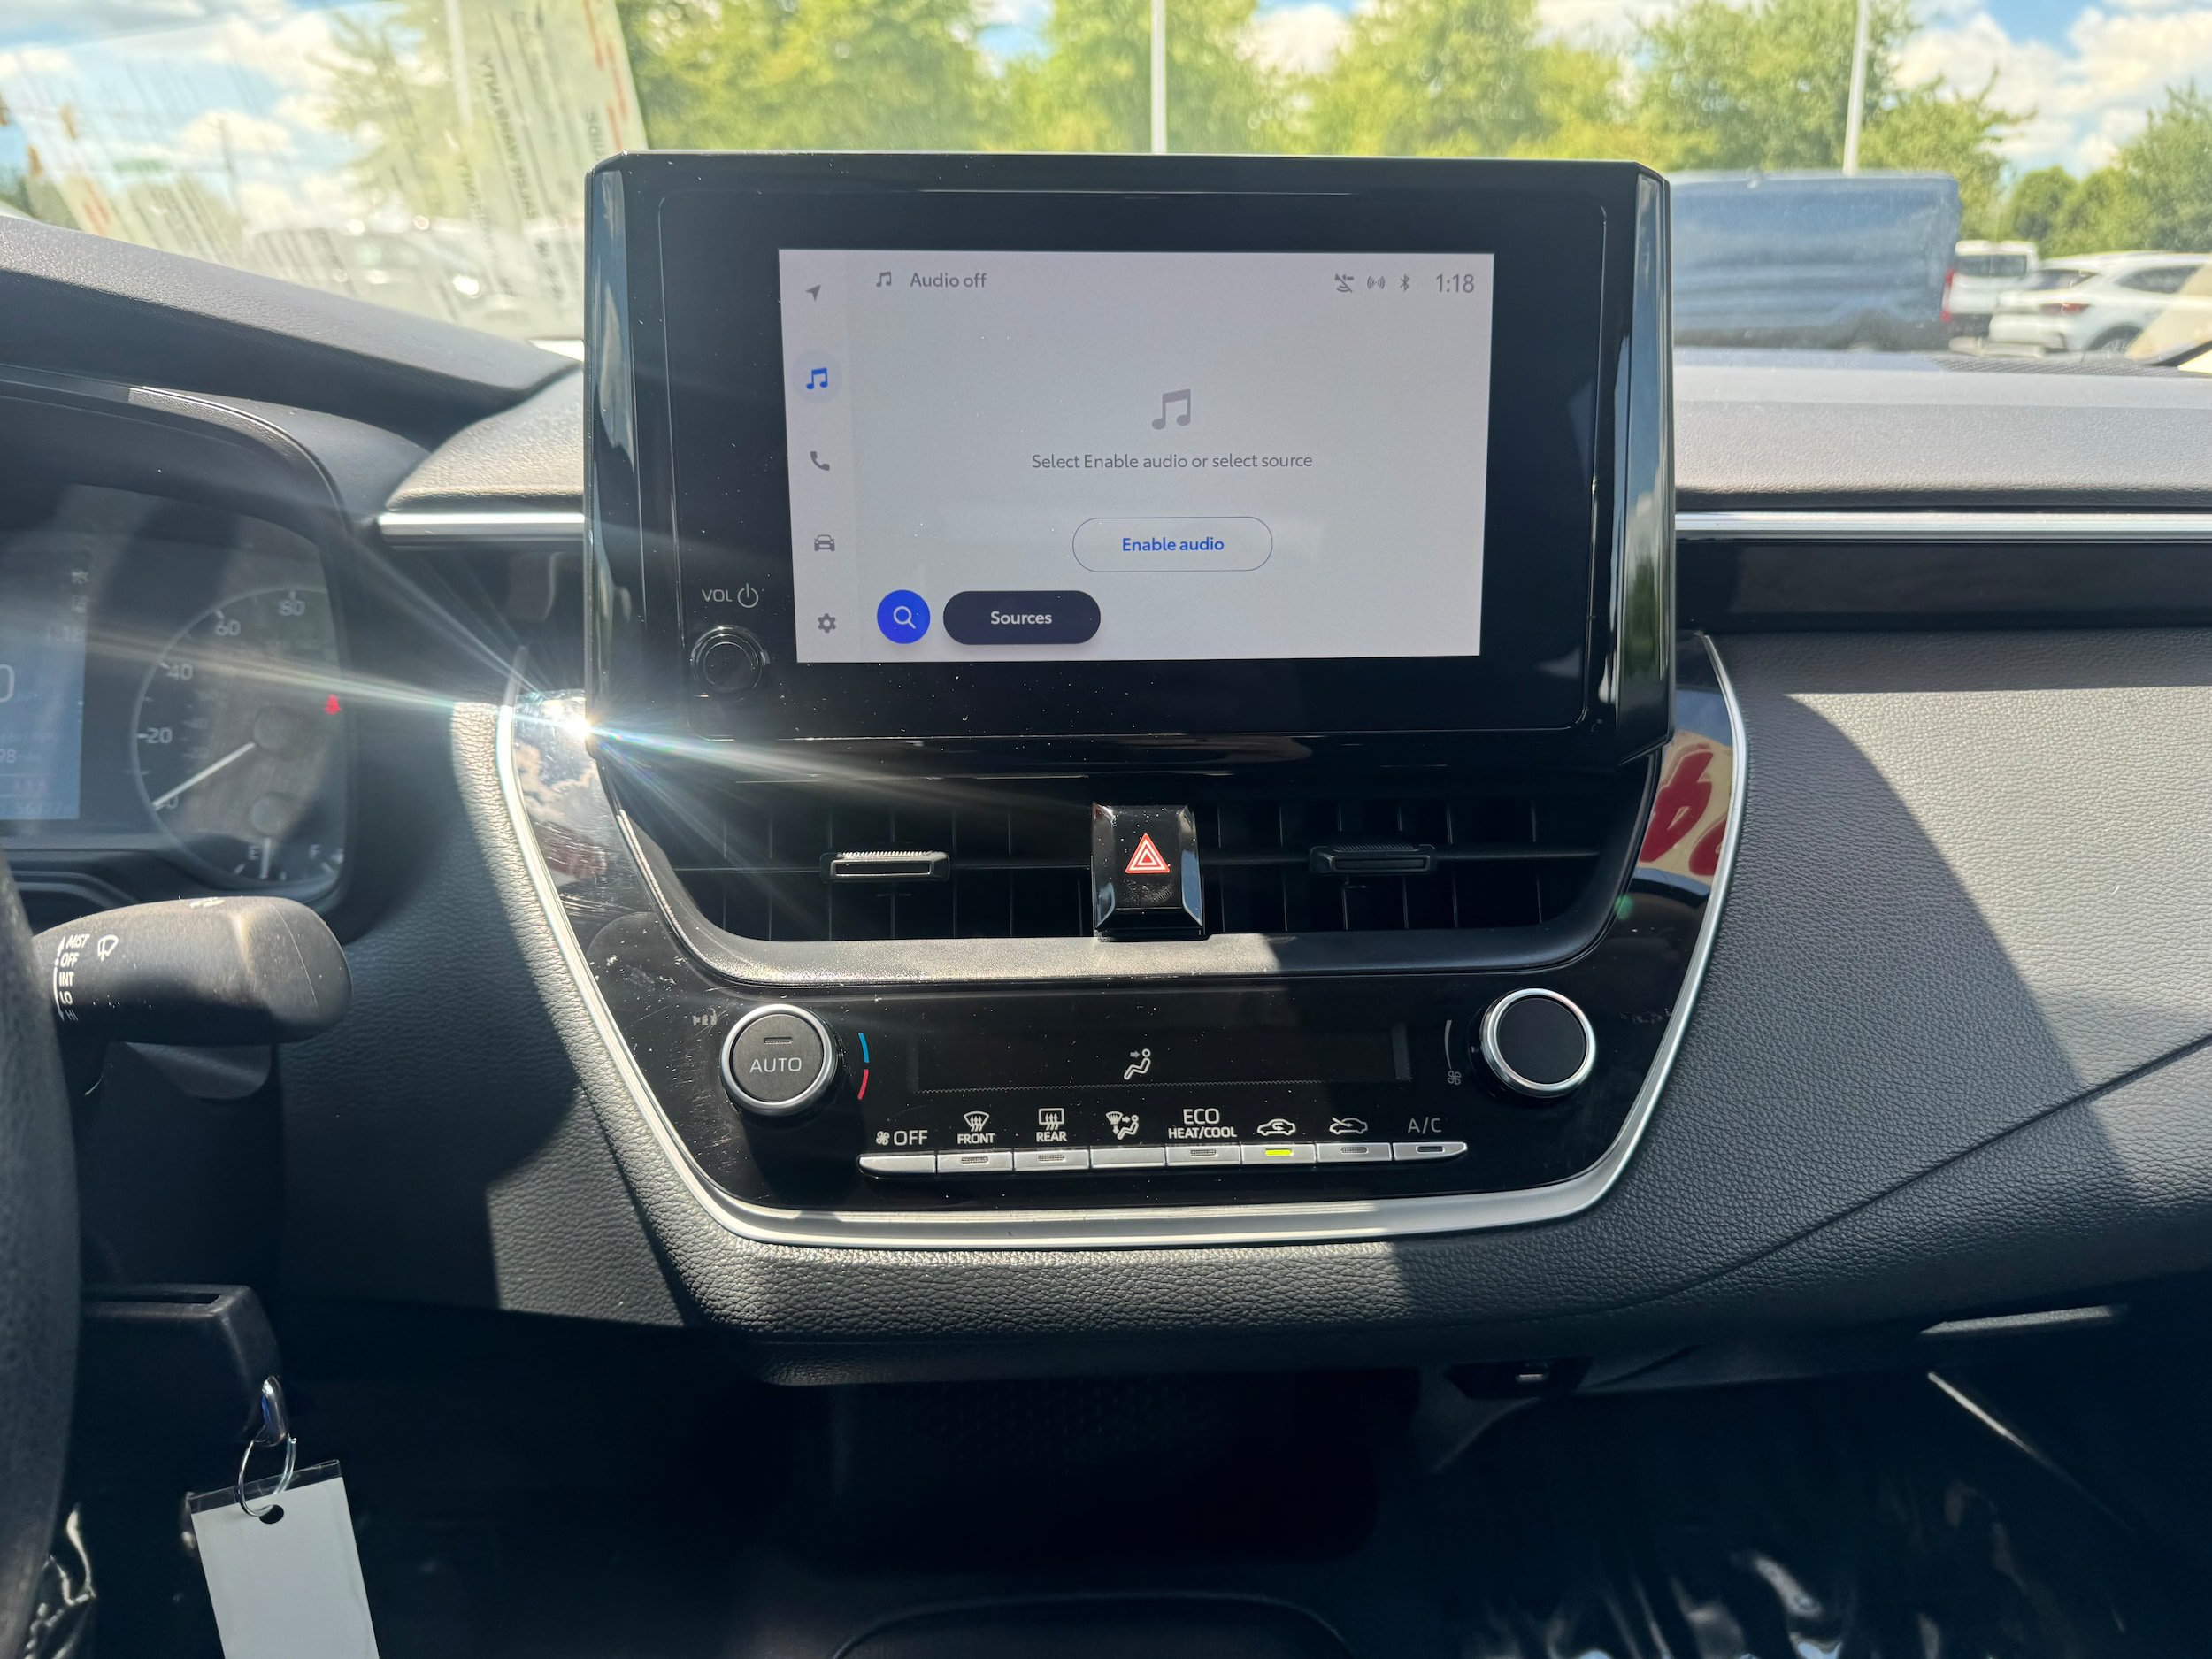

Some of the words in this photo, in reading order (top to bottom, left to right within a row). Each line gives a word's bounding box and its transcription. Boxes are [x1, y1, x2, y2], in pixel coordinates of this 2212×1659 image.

[910, 272, 960, 288] Audio
[963, 272, 987, 288] off
[1436, 273, 1475, 294] 1:18
[1032, 454, 1080, 469] Select
[1084, 454, 1139, 469] Enable
[1142, 454, 1188, 468] audio
[1191, 457, 1209, 468] or
[1212, 454, 1258, 468] select
[1261, 457, 1313, 467] source
[1122, 537, 1177, 552] Enable
[1179, 537, 1225, 551] audio
[701, 588, 733, 603] VOL
[279, 599, 305, 616] 80
[990, 611, 1053, 625] Sources
[215, 620, 241, 636] 60
[165, 664, 193, 680] 40
[147, 727, 173, 744] 20
[65, 933, 90, 949] MIST
[60, 952, 80, 968] OFF
[59, 972, 75, 987] INT
[59, 991, 73, 1005] LO
[749, 1056, 803, 1073] AUTO
[1182, 1107, 1220, 1125] ECO
[1167, 1125, 1237, 1139] HEAT/COOL
[1407, 1117, 1442, 1134] A/C
[893, 1129, 928, 1146] OFF
[956, 1133, 995, 1145] FRONT
[1035, 1131, 1067, 1142] REAR
